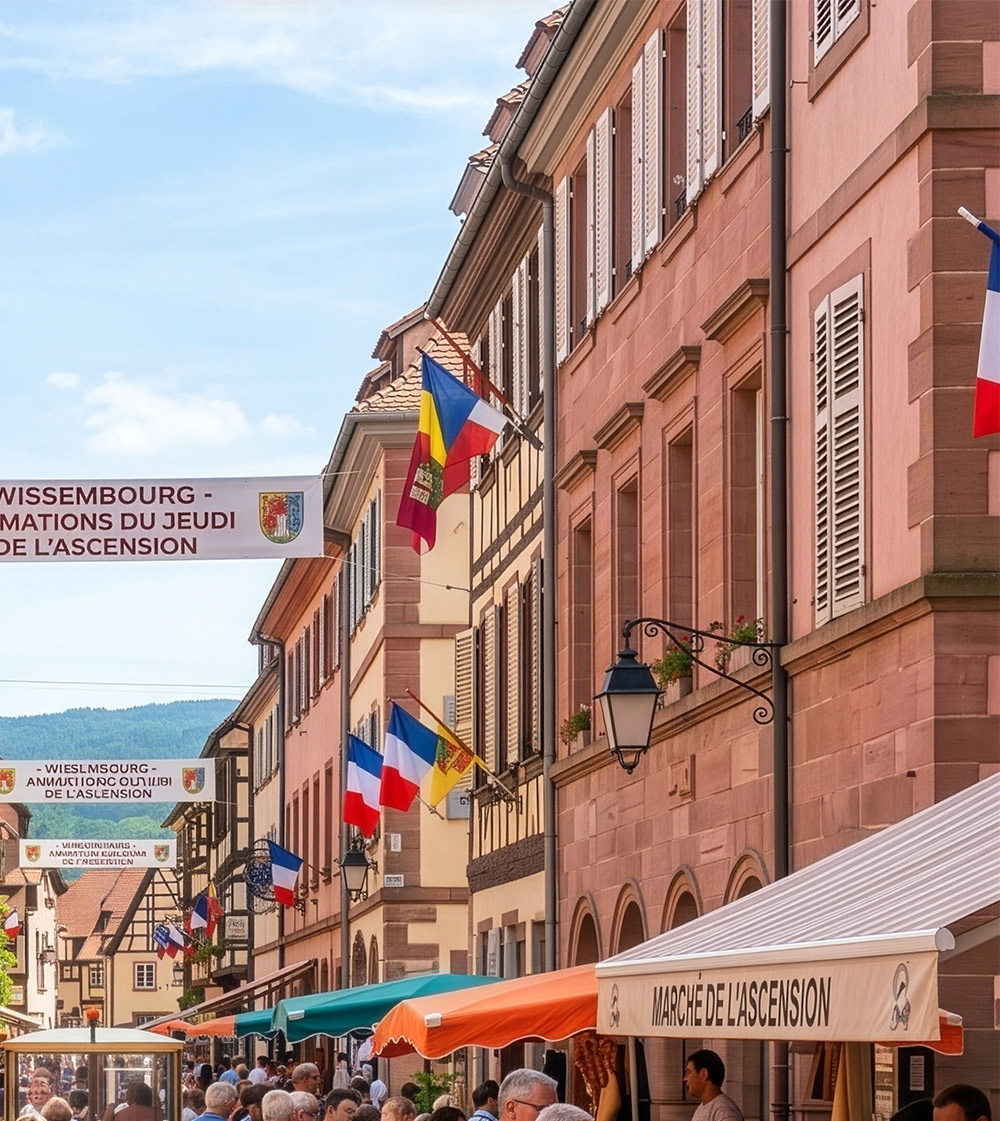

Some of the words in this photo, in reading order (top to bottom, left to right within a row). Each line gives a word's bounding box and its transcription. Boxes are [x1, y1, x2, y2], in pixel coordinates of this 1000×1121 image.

[120, 512, 155, 530] DU
[162, 511, 235, 530] JEUDI
[34, 537, 197, 556] L'ASCENSION
[45, 789, 62, 799] DE
[651, 971, 703, 1027] MARCHÉ
[705, 983, 725, 1027] DE
[727, 976, 831, 1027] L'ASCENSION
